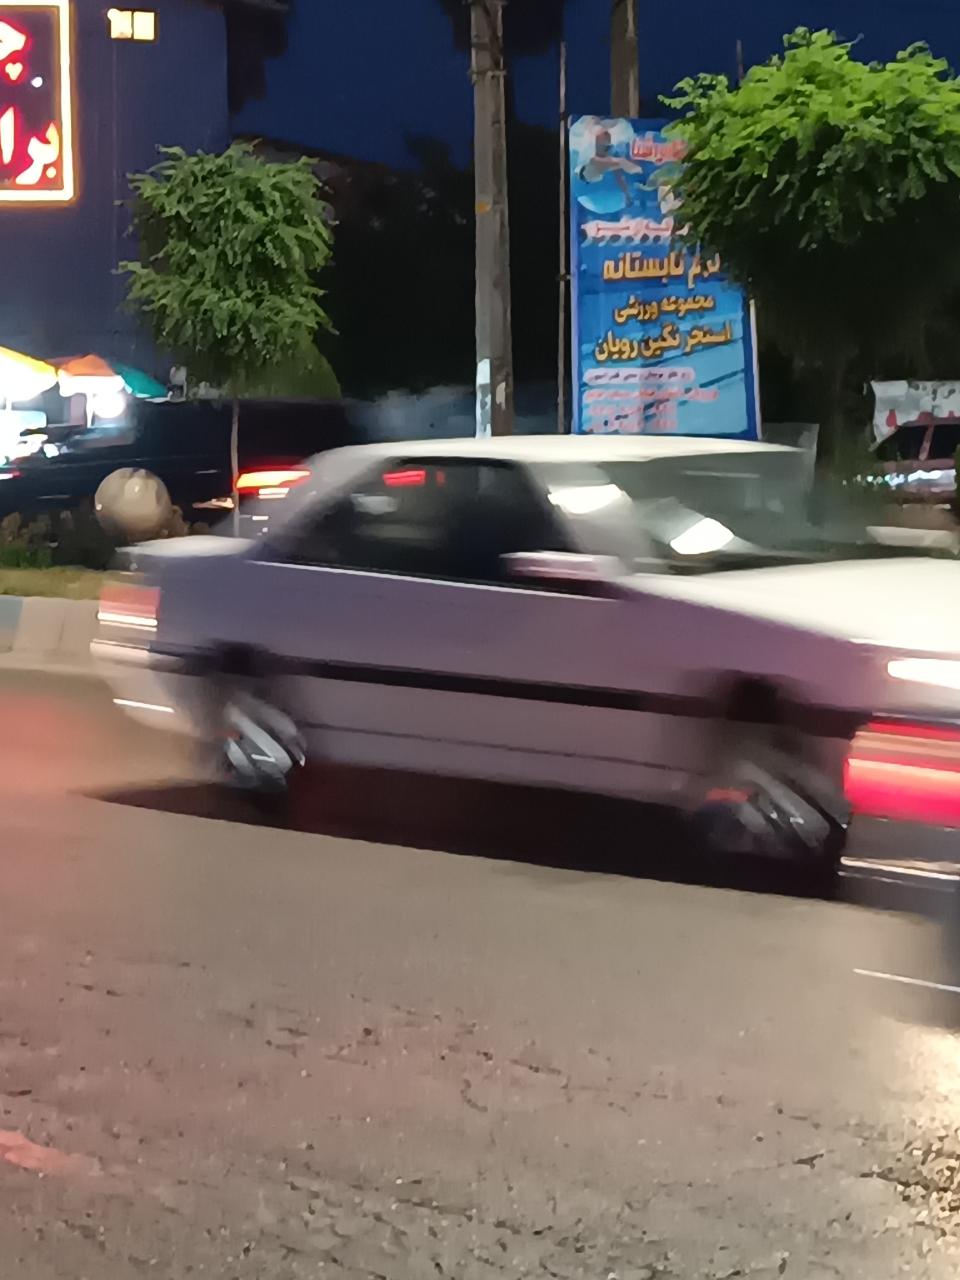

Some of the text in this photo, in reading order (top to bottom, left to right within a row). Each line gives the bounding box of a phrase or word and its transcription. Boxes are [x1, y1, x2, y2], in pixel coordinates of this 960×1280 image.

[603, 250, 685, 284] تابستانه
[660, 295, 715, 318] مجموعه
[594, 329, 639, 361] رویان
[683, 320, 731, 353] استخر
